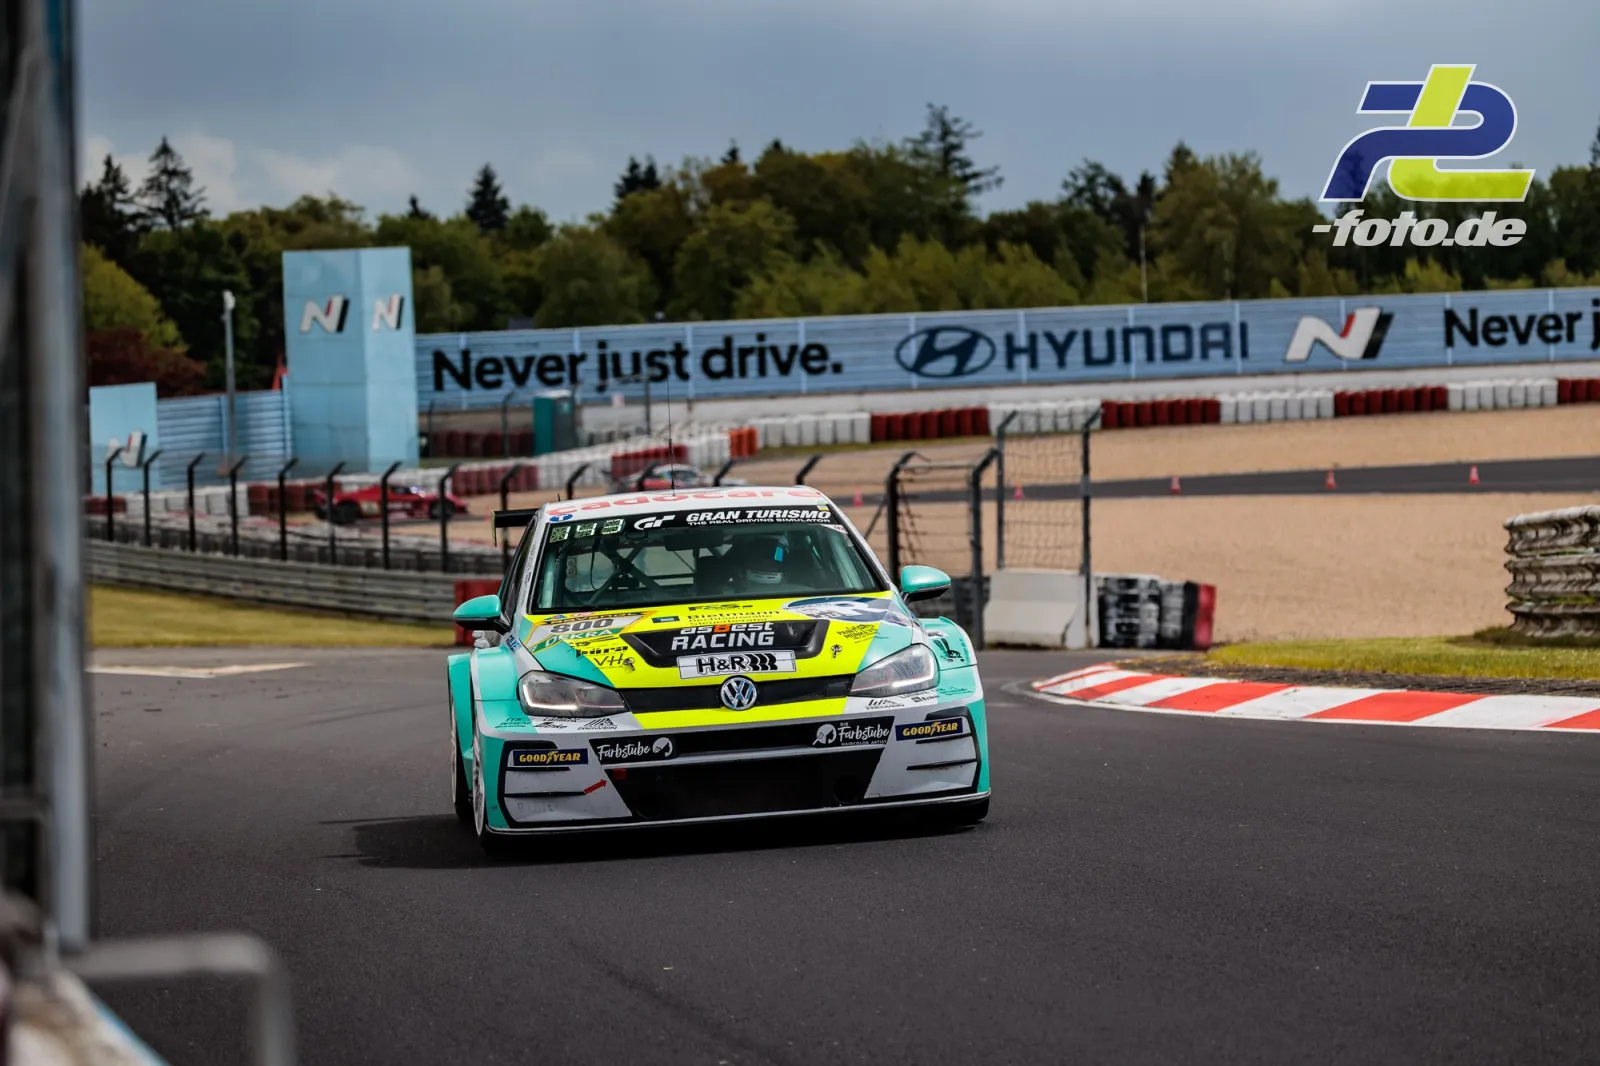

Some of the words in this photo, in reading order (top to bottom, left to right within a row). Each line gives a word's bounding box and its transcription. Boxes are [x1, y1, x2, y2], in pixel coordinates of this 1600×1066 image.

[1444, 307, 1582, 347] Never
[1005, 320, 1248, 371] HYUNDAI
[433, 349, 587, 391] Never
[596, 339, 690, 393] just
[701, 332, 843, 379] drive.
[547, 491, 821, 515] cadocare
[686, 511, 743, 522] GRAN
[746, 510, 832, 519] TURISMO
[550, 618, 614, 633] 800
[671, 631, 775, 650] RACING
[697, 656, 747, 673] H&R
[838, 724, 890, 742] Farbstube
[902, 721, 958, 737] GOODYEAR
[519, 751, 581, 765] GOODYEAR
[596, 741, 651, 760] Farbstube
